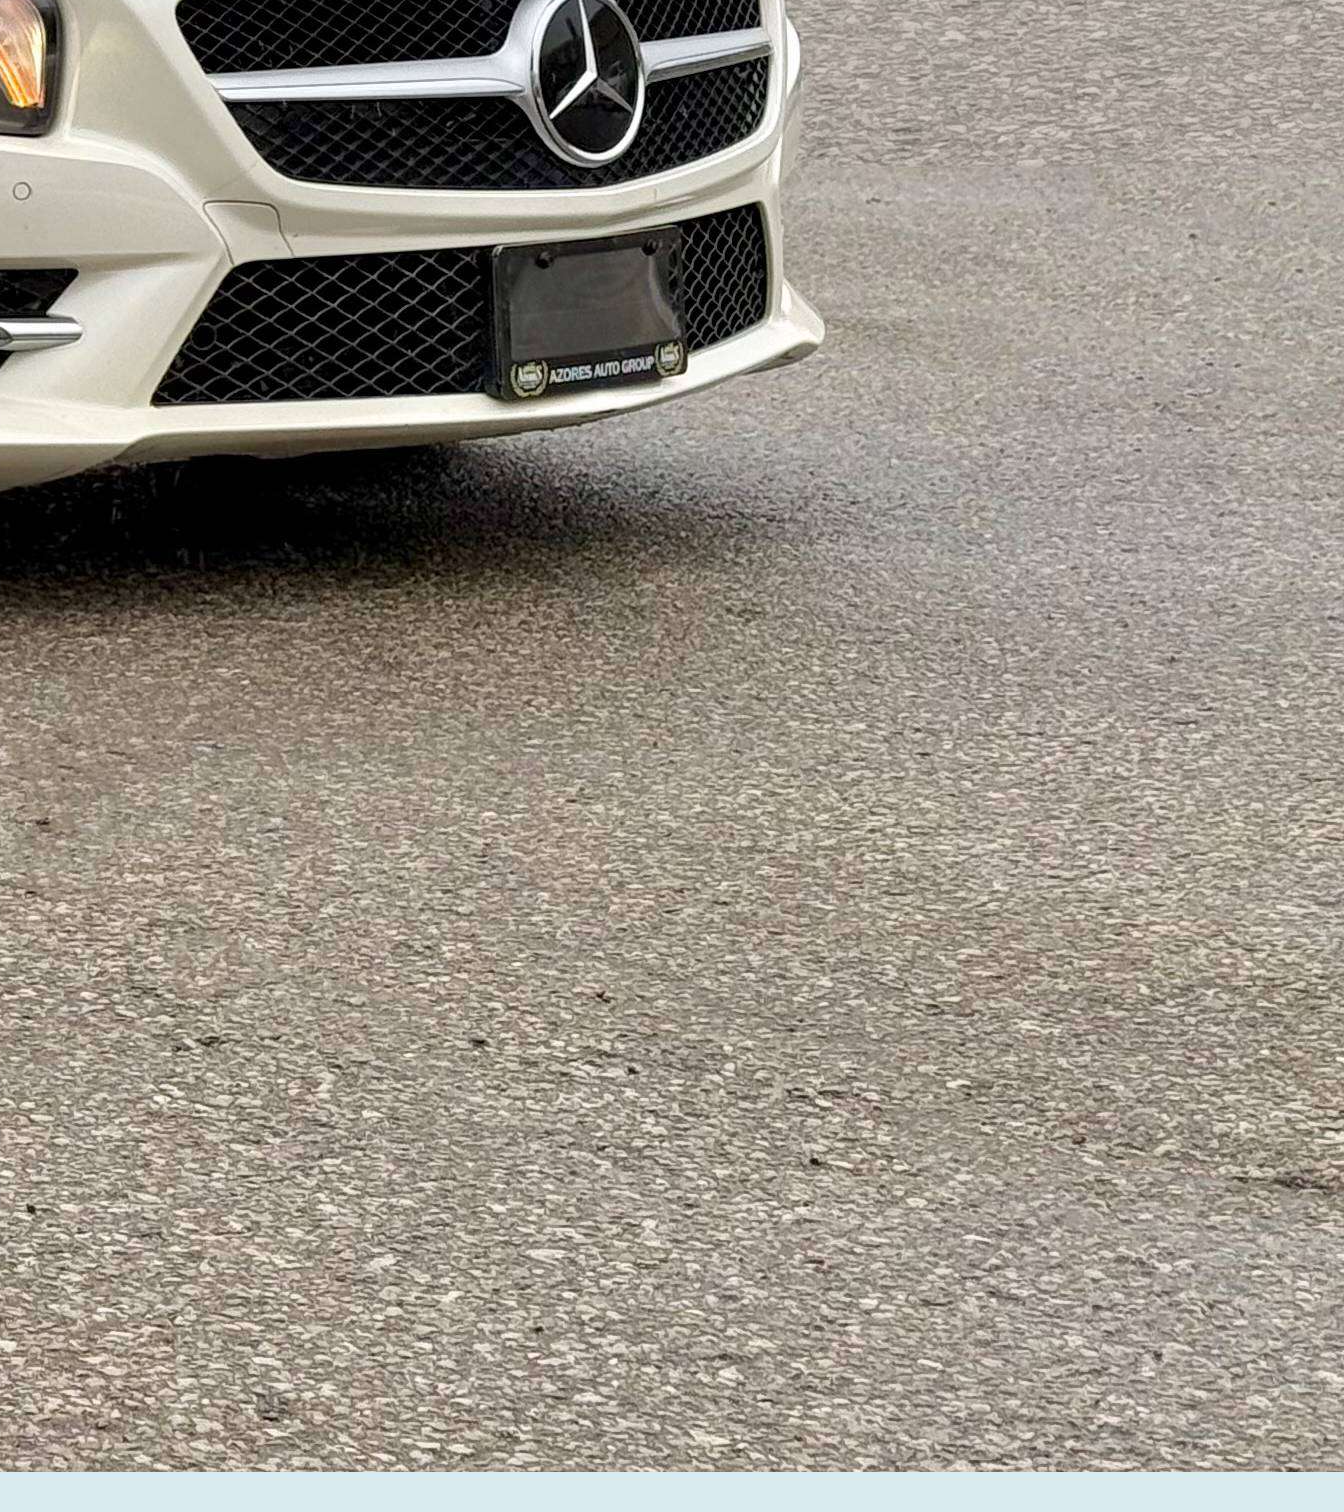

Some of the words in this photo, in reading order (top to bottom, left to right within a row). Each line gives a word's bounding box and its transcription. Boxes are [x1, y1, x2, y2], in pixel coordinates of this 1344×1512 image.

[549, 364, 593, 385] AZORES
[593, 361, 620, 378] AUTO
[621, 355, 656, 374] GROUP
